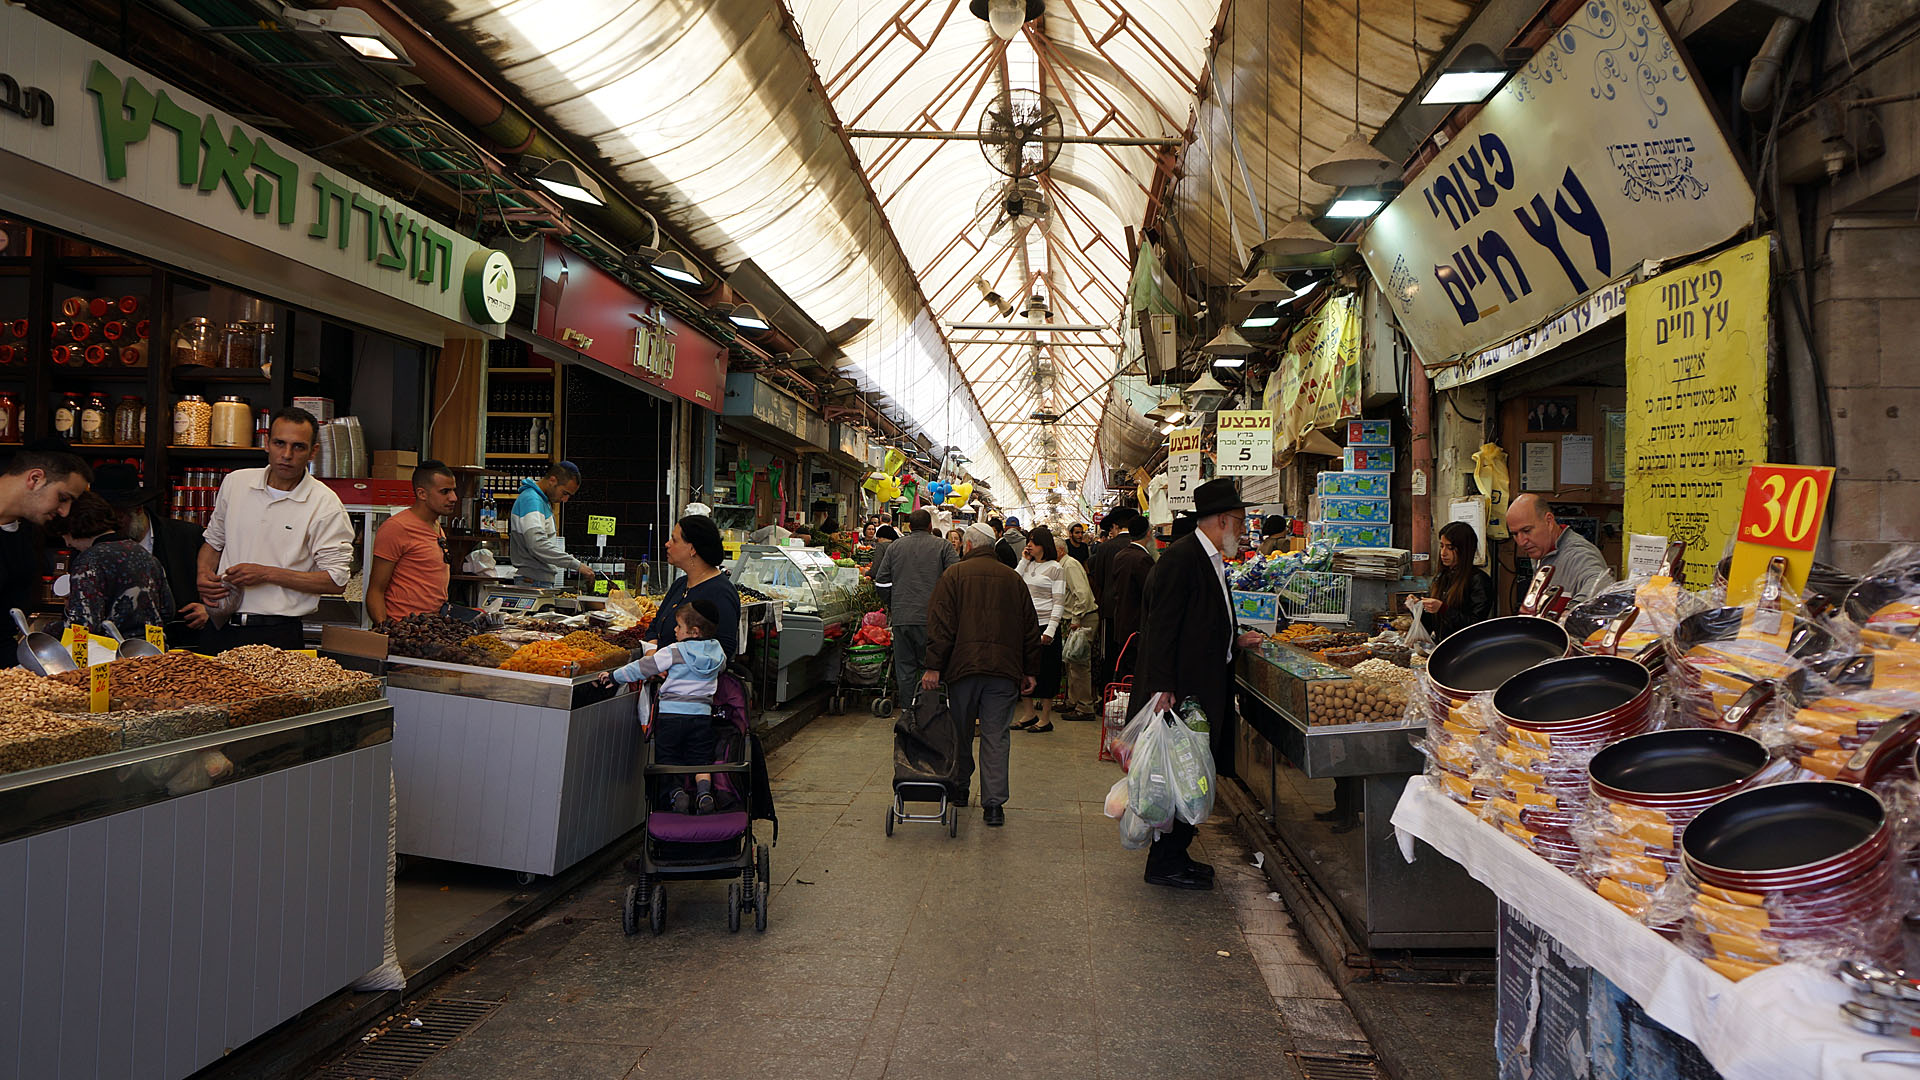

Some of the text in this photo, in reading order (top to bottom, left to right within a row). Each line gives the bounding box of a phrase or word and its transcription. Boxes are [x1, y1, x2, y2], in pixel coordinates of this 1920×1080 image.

[1644, 137, 1696, 156] בהשגחת
[86, 60, 453, 293] תוצרת הארץ
[1422, 133, 1515, 231] פצוחי
[1513, 165, 1612, 296] עץ
[1434, 229, 1533, 326] חיים
[1662, 269, 1723, 311] פיצוחי
[1597, 281, 1631, 313] צוחי
[1571, 300, 1591, 332] עץ
[1656, 299, 1729, 345] עץ חיים
[1673, 352, 1706, 375] אישור
[1645, 385, 1737, 414] אנו מאשרים בזה כי
[1220, 416, 1271, 429] מבצע
[1170, 434, 1200, 453] מבצע
[1239, 448, 1251, 461] 5
[1638, 449, 1745, 471] פירות יבשים ותבלינים
[1179, 475, 1187, 491] 5
[1651, 481, 1723, 499] הנמכרים בחנות
[1752, 474, 1819, 543] 30
[606, 521, 614, 533] 3
